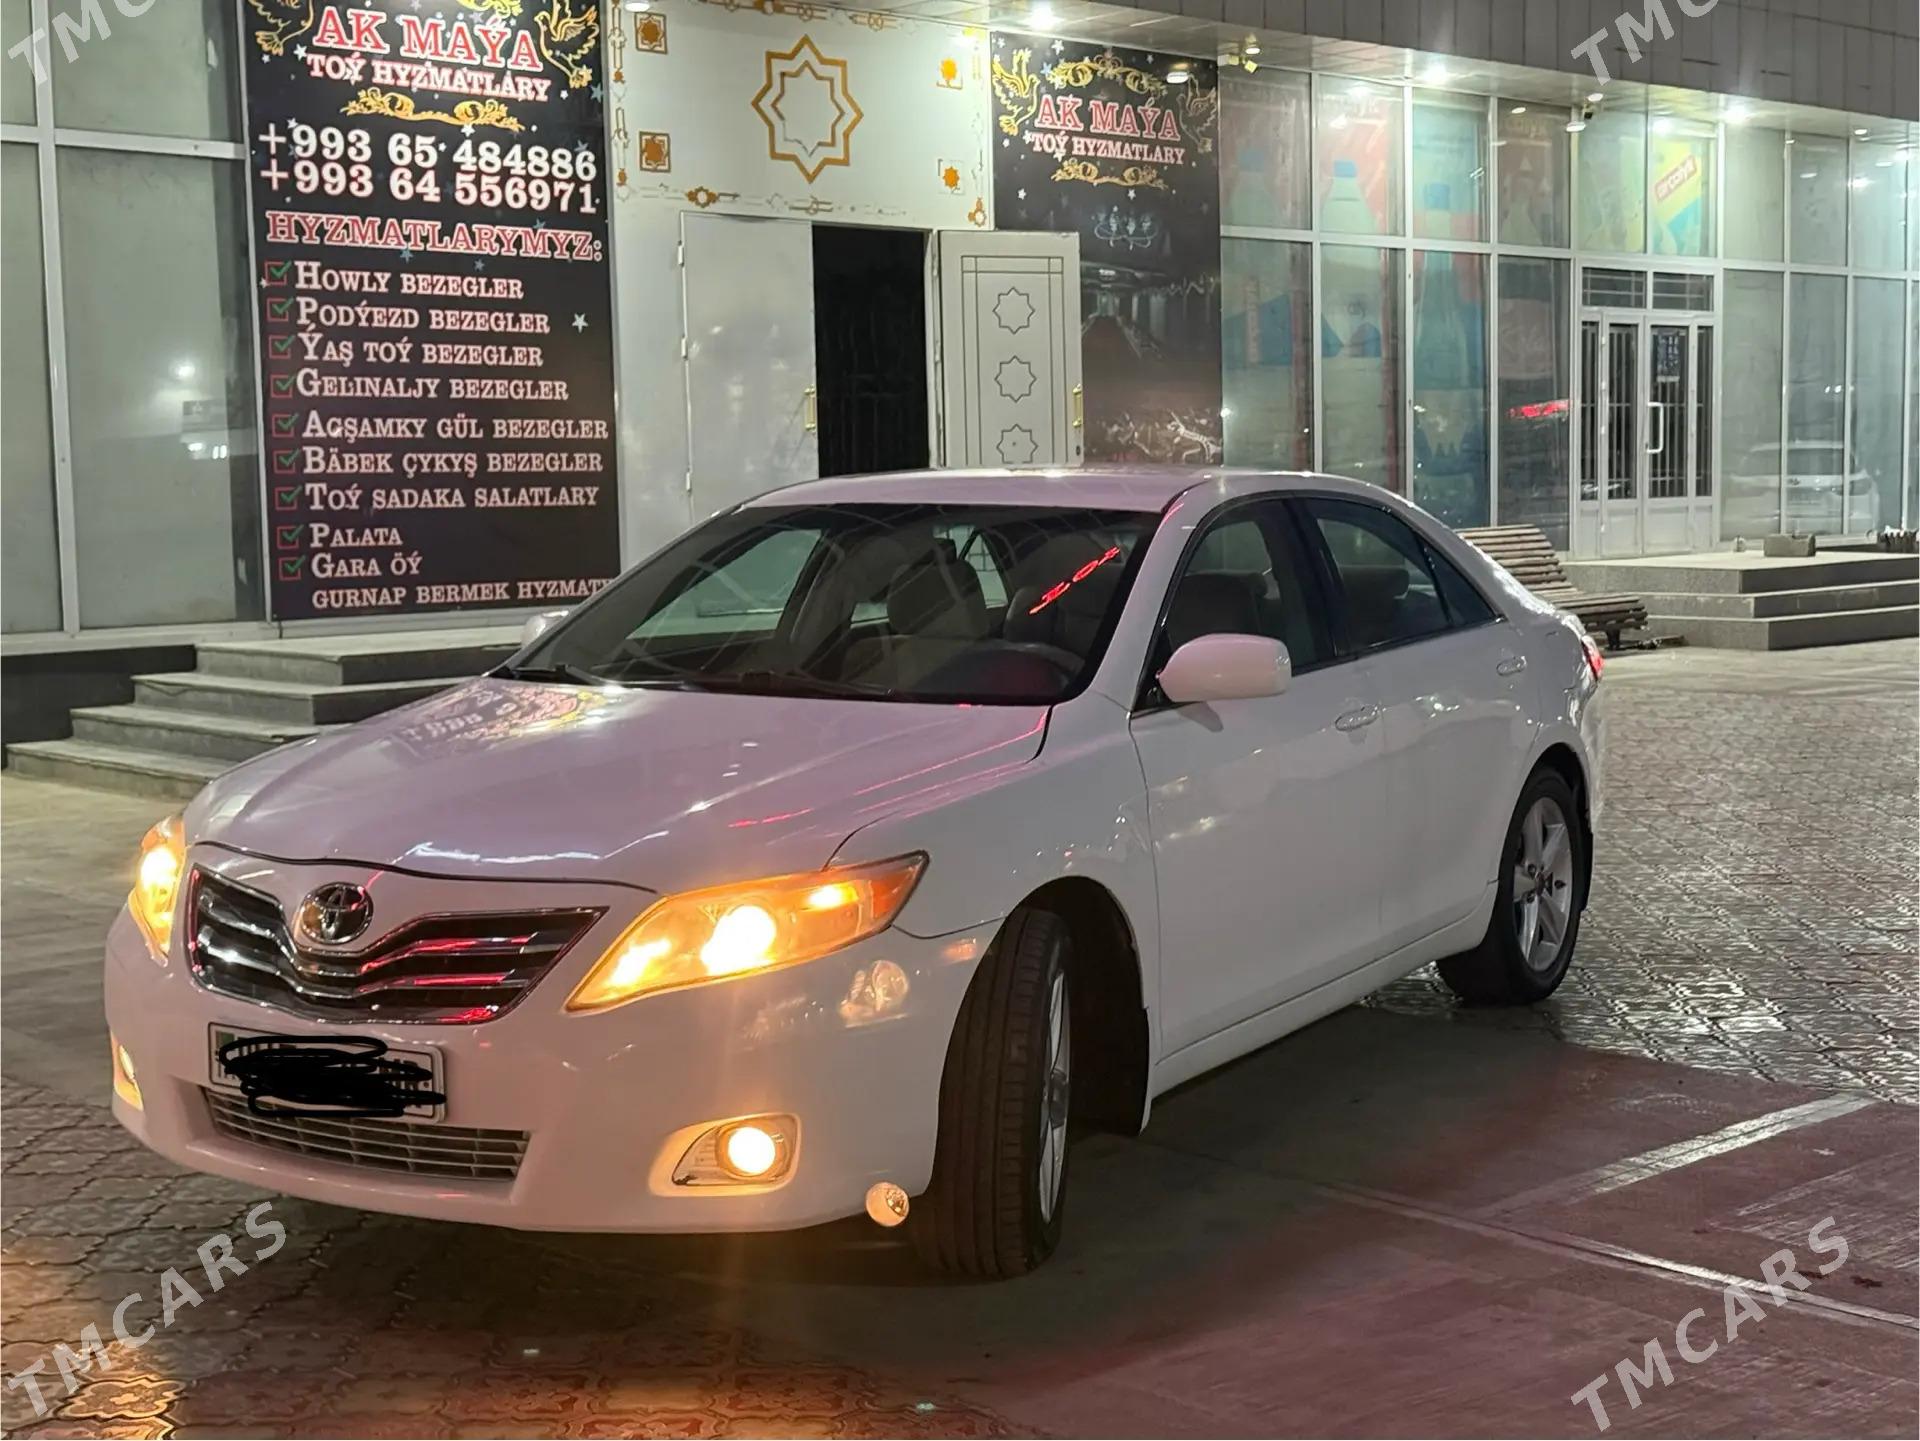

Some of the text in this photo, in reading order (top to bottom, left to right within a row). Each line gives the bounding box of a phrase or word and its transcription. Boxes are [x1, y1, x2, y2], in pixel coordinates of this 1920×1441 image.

[312, 5, 543, 71] AK MAÝA
[307, 53, 551, 102] TOÝ HYZMATLARY
[1034, 94, 1181, 141] AK MAÝA
[259, 122, 596, 181] +993 65 484886
[1031, 131, 1185, 165] TOÝ HYZMATLARY
[260, 159, 597, 213] +993 64 556971
[266, 210, 602, 262] HYZMATLARYMYZ:
[295, 261, 524, 299] HOWLY BEZEGLER
[296, 297, 550, 333] PODÝEZD BEZEGLER
[298, 324, 543, 367] ÝAŞ TOÝ BEZEGLER
[296, 368, 569, 400] GELINALJY BEZEGLER
[437, 413, 483, 439] GÜL
[492, 419, 609, 439] BEZEGLER
[303, 446, 603, 478] BÄBEK ÇYKYŞ BEZEGLER
[305, 483, 599, 510] TOÝ SADAKA SALATLARY
[309, 523, 402, 548] PALATA
[311, 551, 422, 578] GARA ÖÝ
[312, 588, 406, 609] GURNAP
[416, 582, 509, 605] BERMEK
